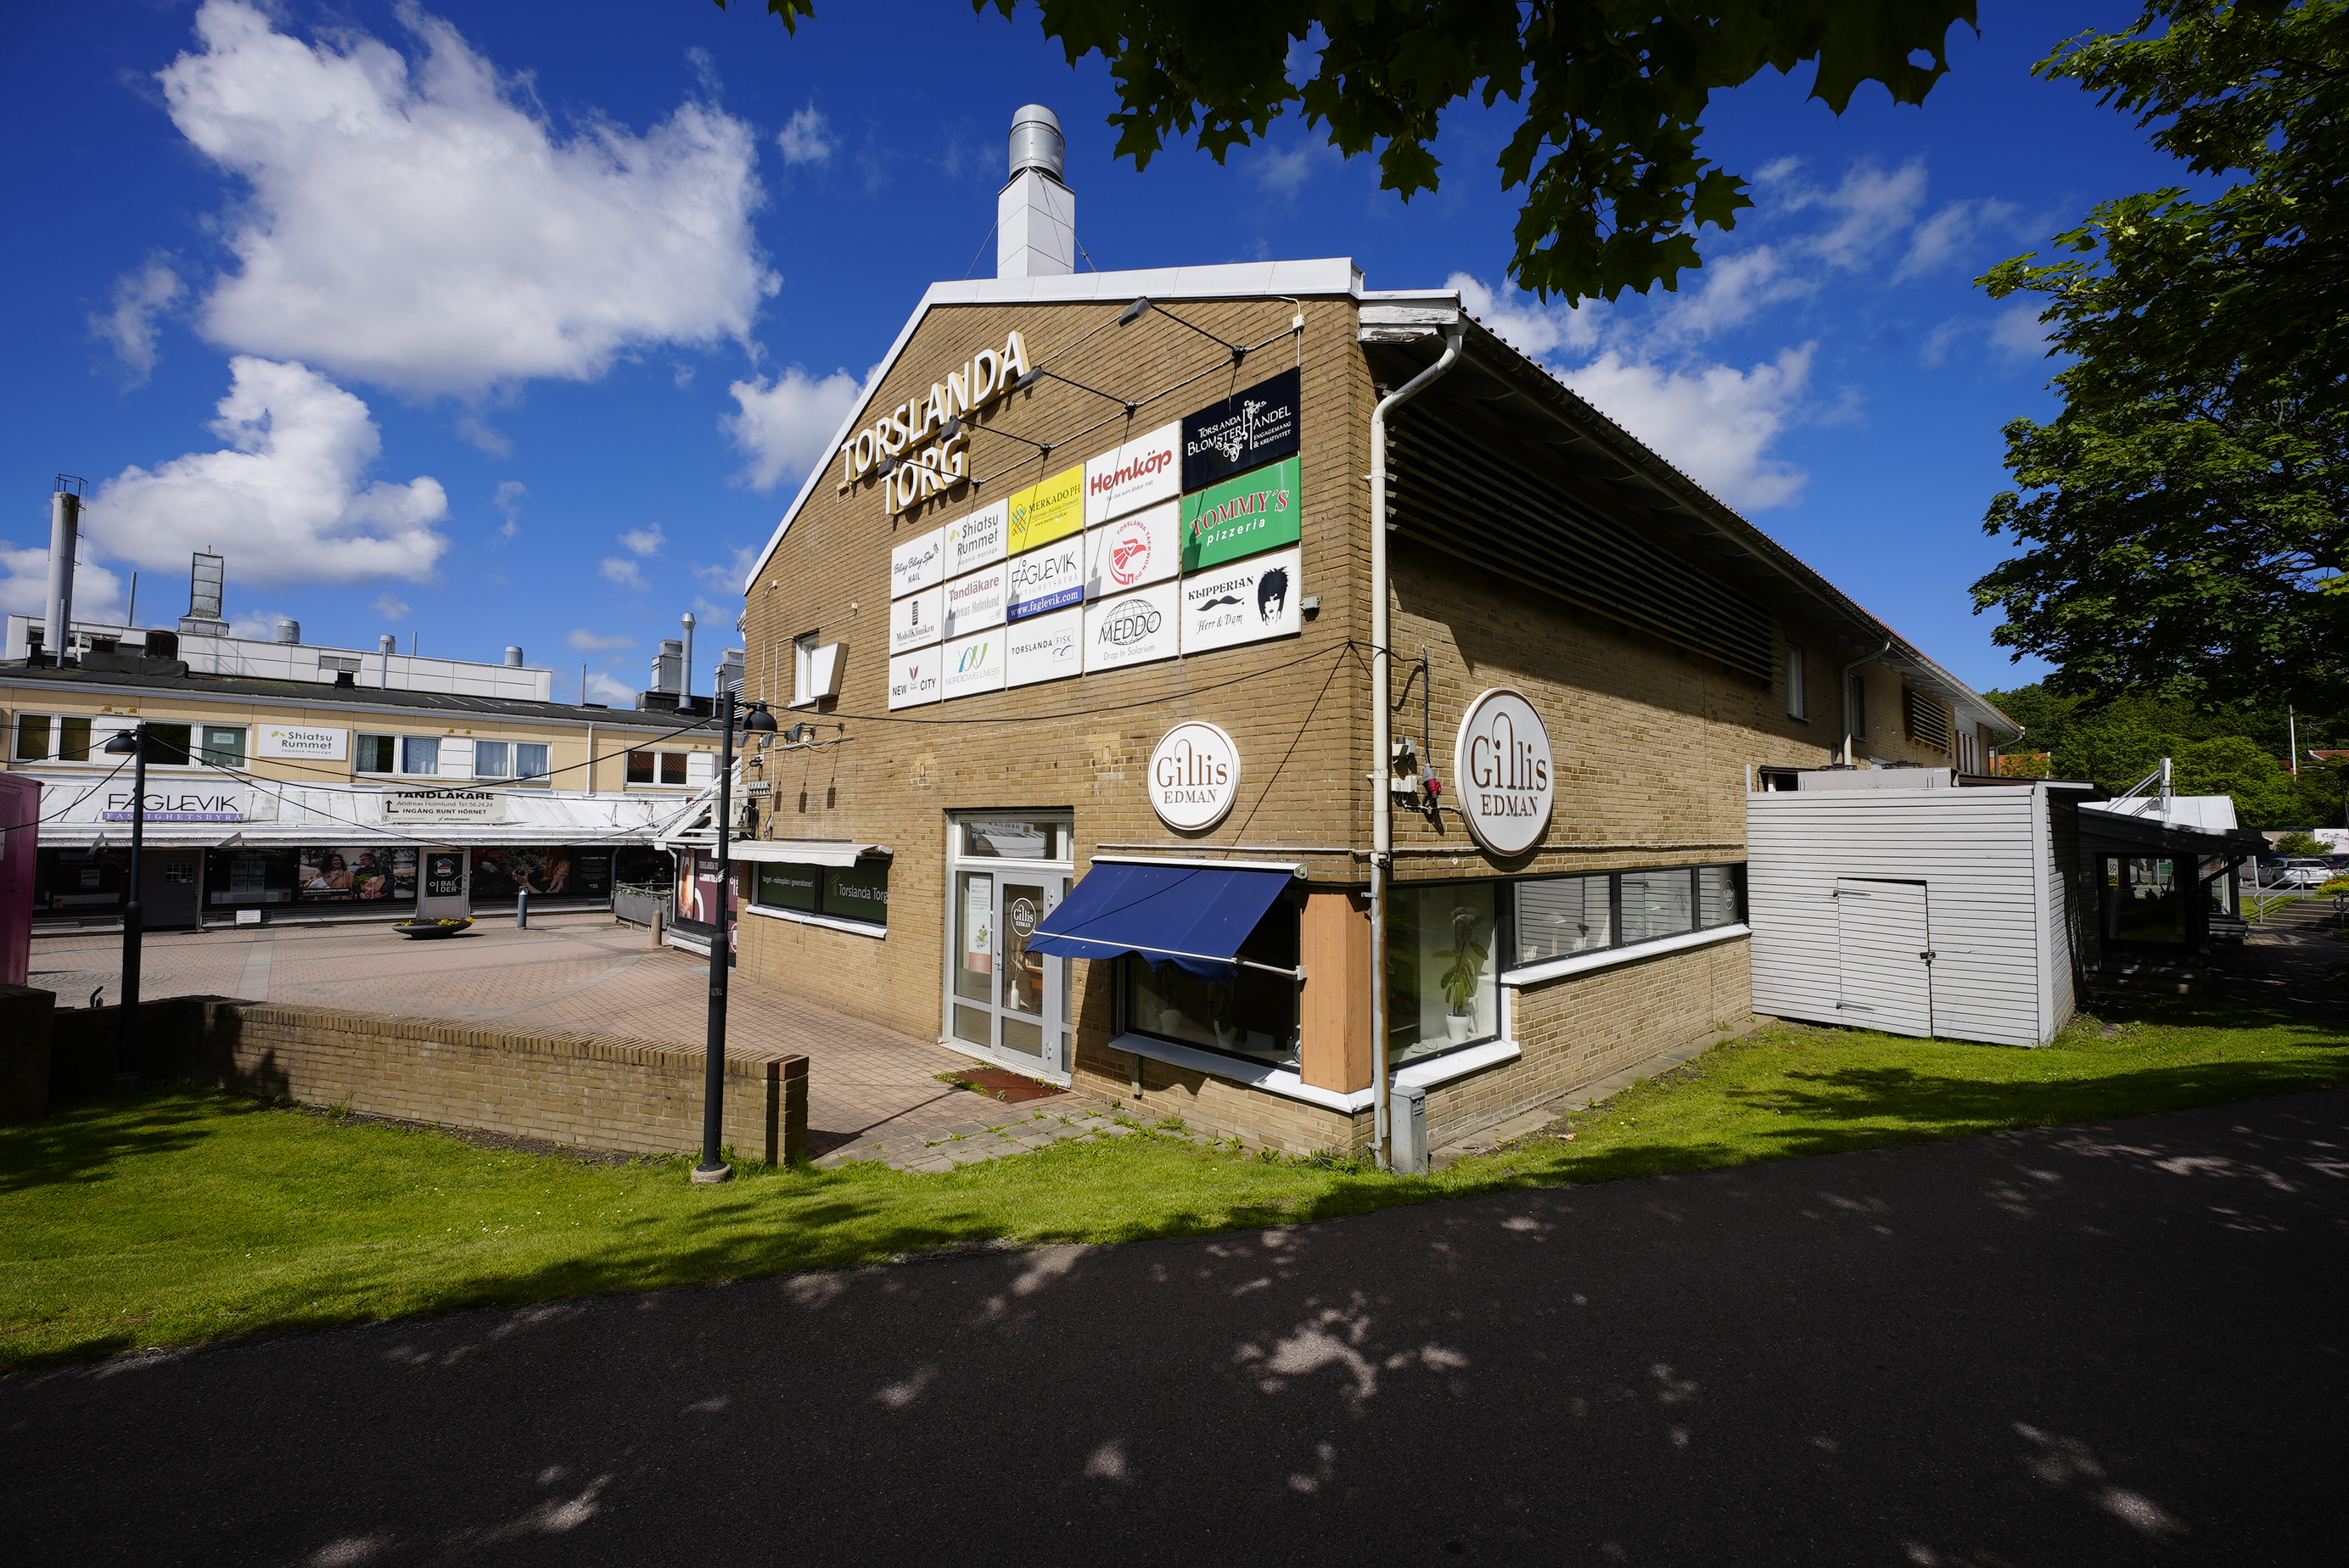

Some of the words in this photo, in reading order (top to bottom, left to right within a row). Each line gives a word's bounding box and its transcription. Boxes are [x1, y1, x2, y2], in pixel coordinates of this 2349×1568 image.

[841, 330, 1030, 484] TORSLANDA
[1198, 415, 1242, 439] TORSLANDA
[1253, 421, 1292, 440] ENGAGEMANG
[1259, 429, 1292, 445] KREATIVITET
[881, 432, 969, 515] TORG
[1090, 450, 1172, 496] Hemköp
[1029, 489, 1069, 513] MERKADO
[1069, 484, 1080, 496] PH
[1189, 489, 1290, 538] TOMMY'S
[962, 514, 998, 539] Shiatsu
[1117, 520, 1146, 535] TORSLANDA
[1207, 518, 1266, 546] pizzeria
[957, 528, 998, 557] Rummet
[908, 572, 920, 584] NAIL
[1012, 551, 1077, 591] FÅGLEVIK
[949, 577, 1000, 602] Tandläkare
[948, 606, 971, 621] Andreas
[972, 592, 1000, 614] Holmlund
[1010, 591, 1079, 617] www.faglevik.com
[1098, 611, 1162, 645] MEDDO
[1197, 619, 1215, 635] Herr
[1217, 616, 1224, 628] &
[1224, 613, 1244, 628] Dam
[1012, 639, 1053, 655] TORSLANDA
[1056, 634, 1072, 645] FISK
[1103, 652, 1118, 661] Drop
[1120, 648, 1125, 657] In
[1127, 645, 1155, 657] Solarium
[893, 684, 908, 697] NEW
[920, 678, 936, 691] CITY
[282, 740, 332, 749] Rummet
[289, 731, 333, 742] Shiatsu
[1156, 739, 1228, 787] Gillis
[1471, 712, 1548, 792] Gillis
[1163, 789, 1217, 804] EDMAN
[1480, 794, 1538, 817] EDMAN
[106, 813, 243, 821] FASIGHETSBYRÅ
[838, 883, 871, 899] Torslanda
[872, 888, 888, 904] Torg
[1013, 904, 1034, 923] Gillis
